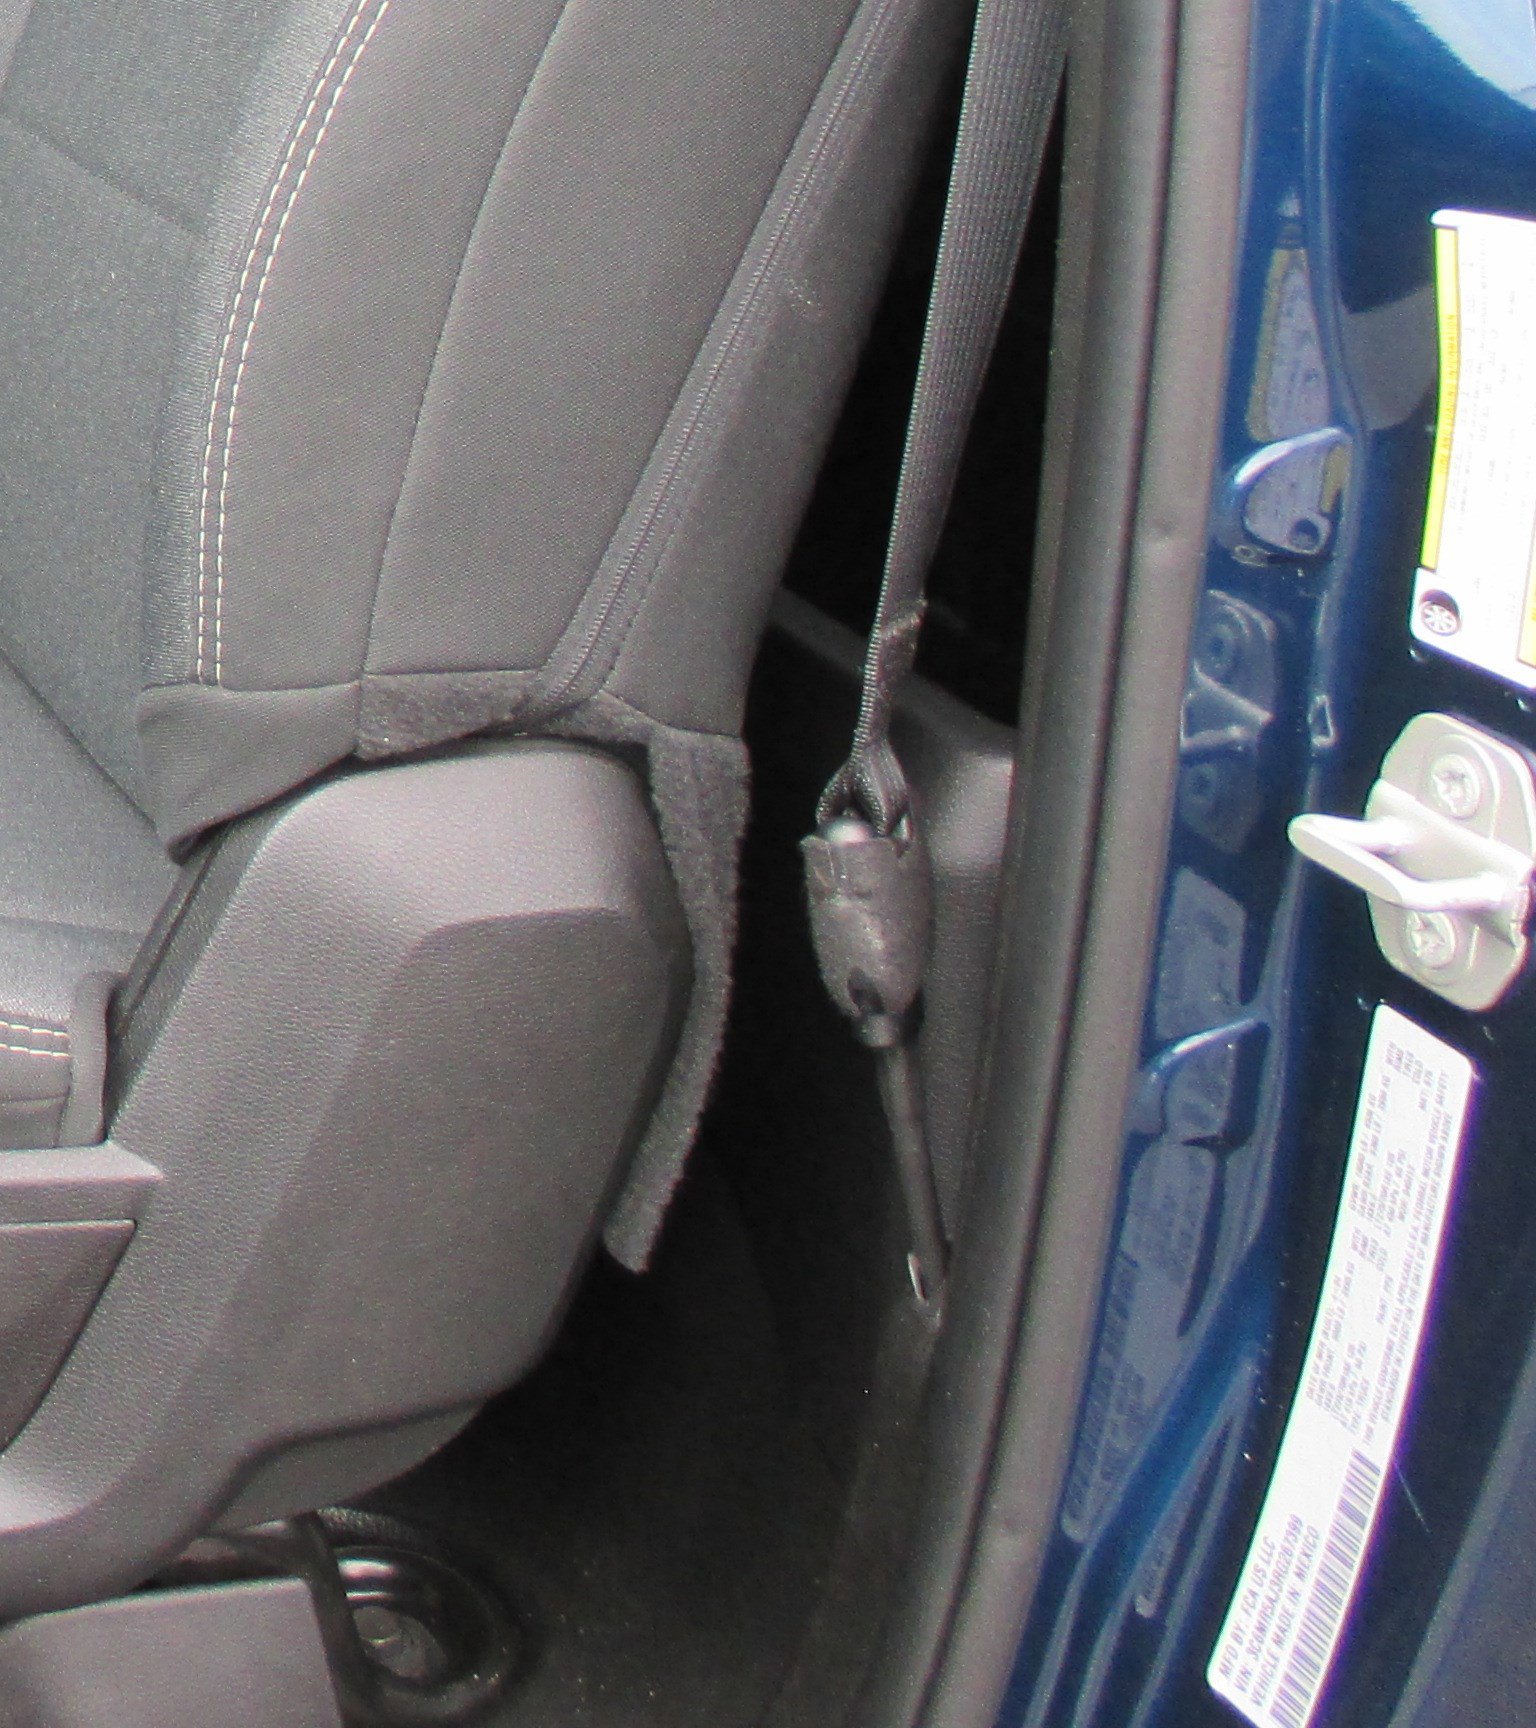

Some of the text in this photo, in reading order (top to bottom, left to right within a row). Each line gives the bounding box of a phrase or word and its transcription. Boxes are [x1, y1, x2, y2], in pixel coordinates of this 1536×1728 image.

[1219, 1536, 1274, 1678] MFD BY: FCA US LLC
[1235, 1661, 1251, 1692] VIN:
[1251, 1525, 1318, 1706] VEHICLE MADE IN: MEXICO
